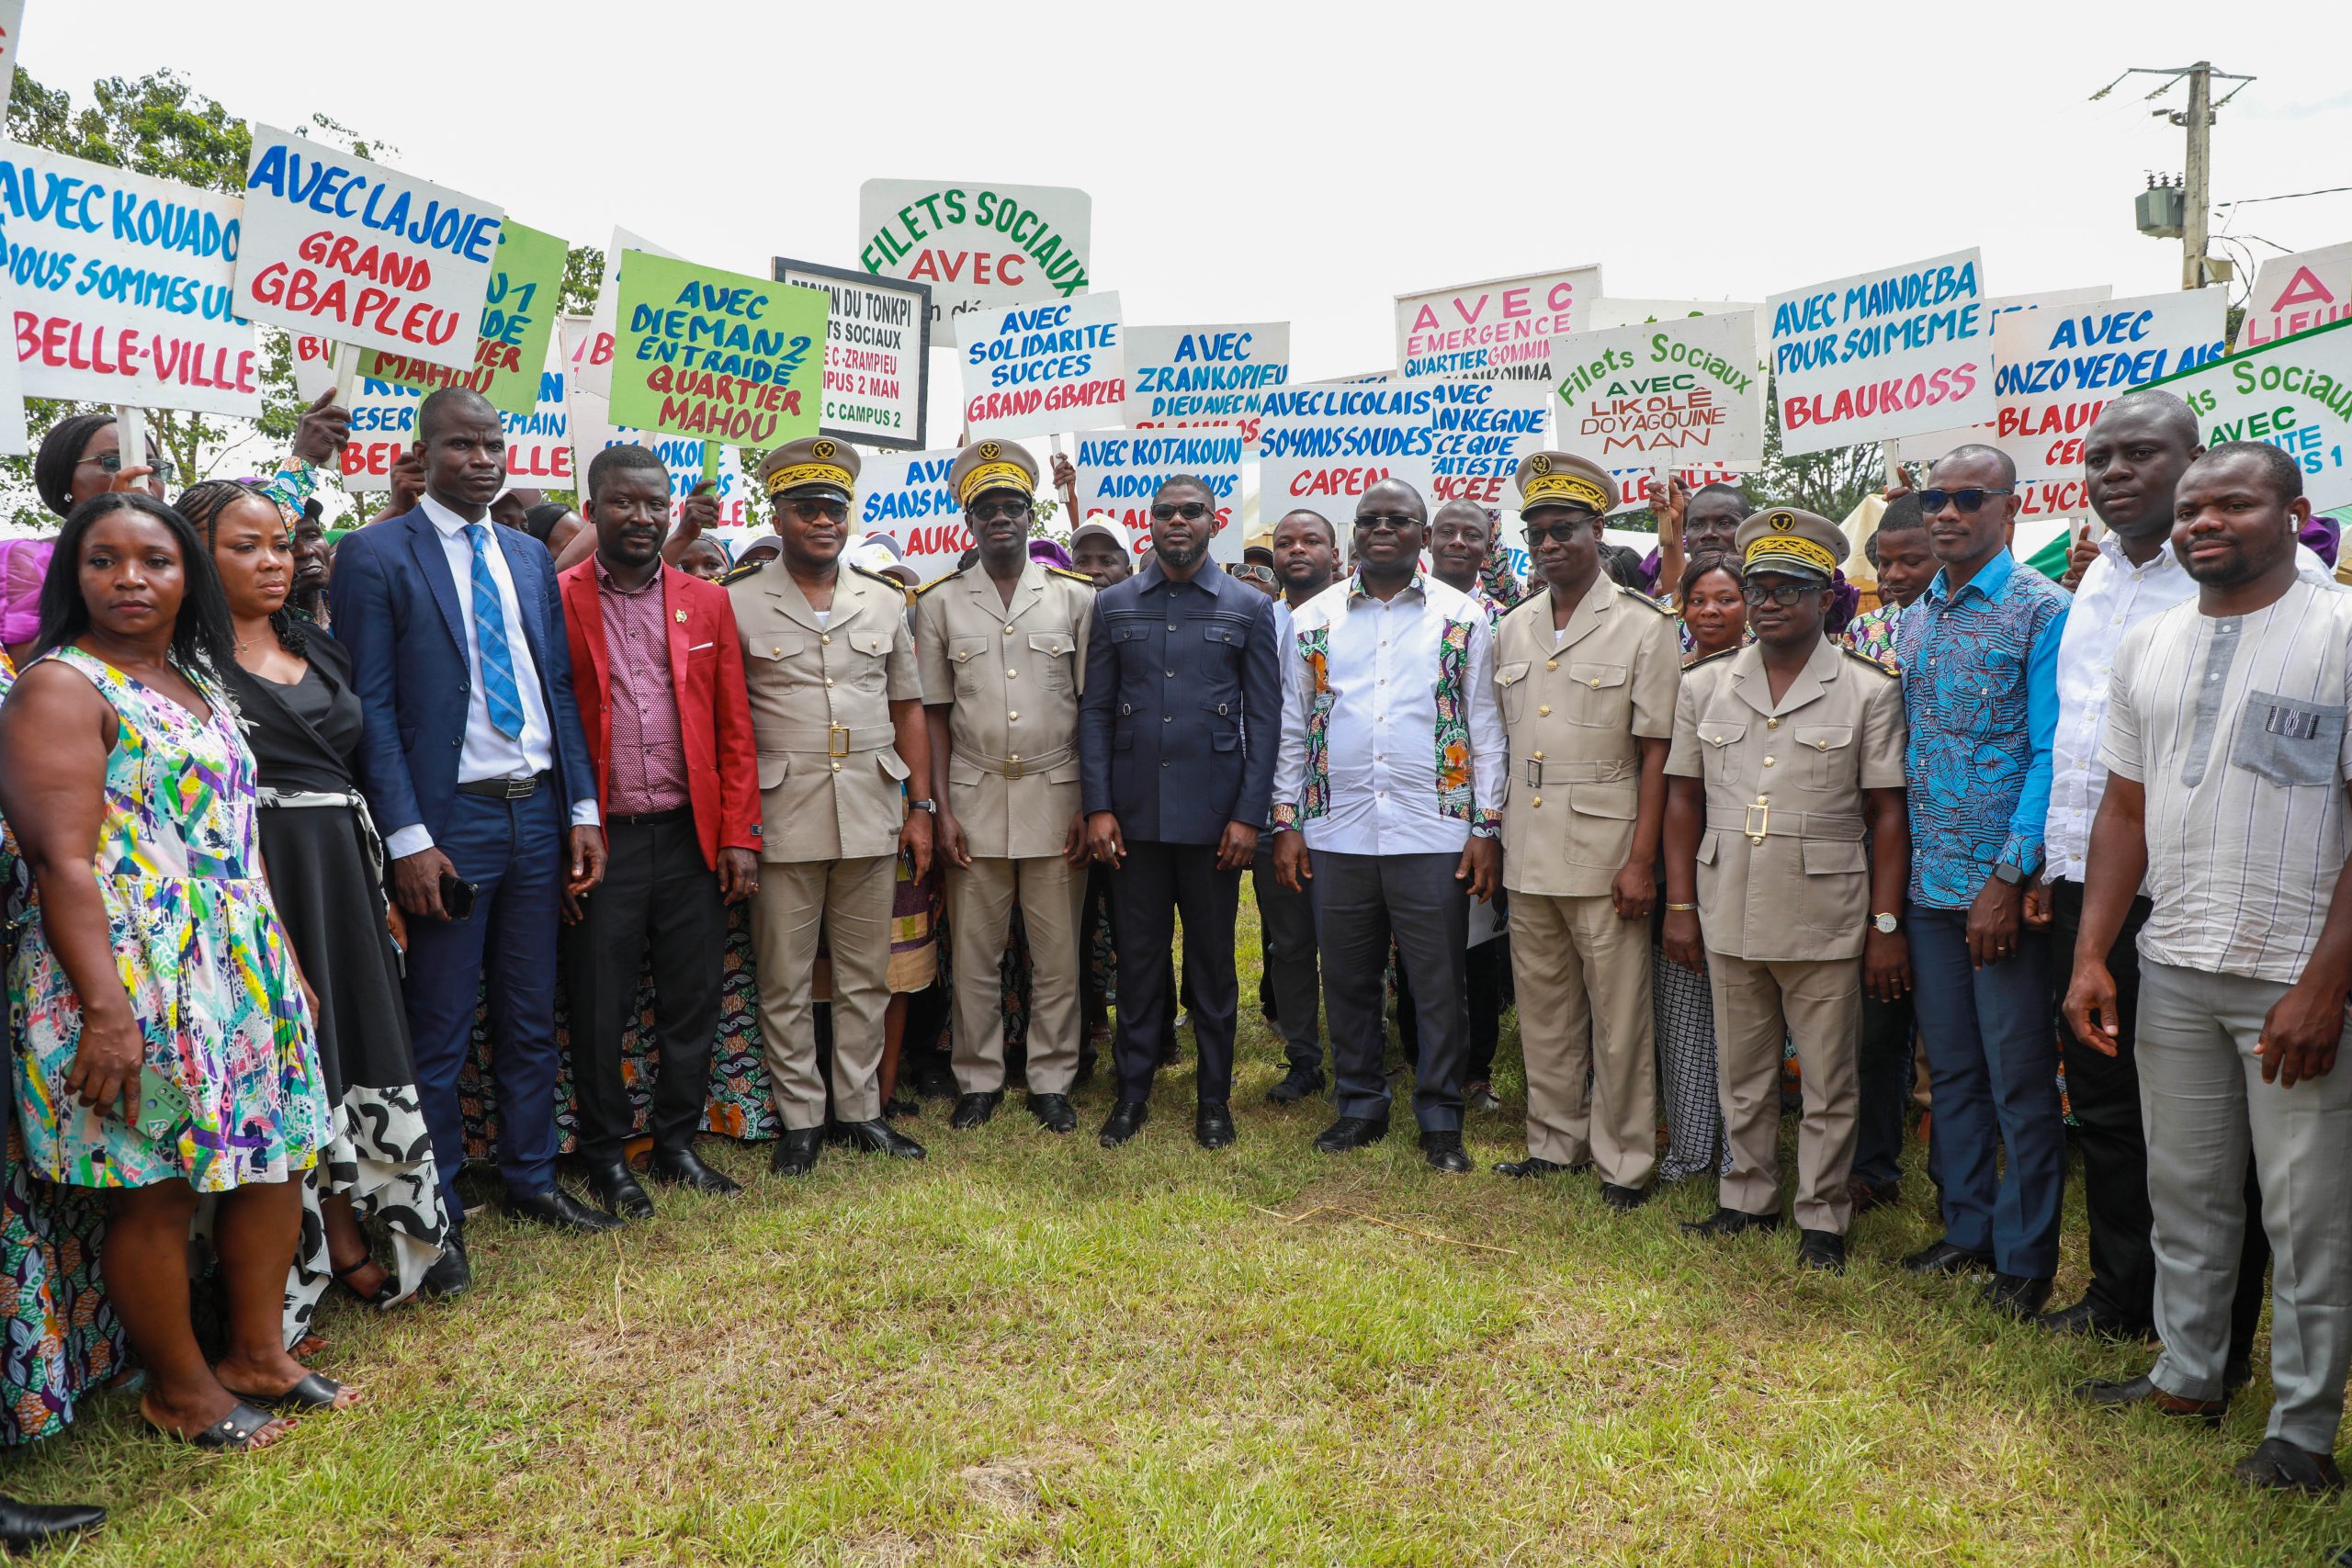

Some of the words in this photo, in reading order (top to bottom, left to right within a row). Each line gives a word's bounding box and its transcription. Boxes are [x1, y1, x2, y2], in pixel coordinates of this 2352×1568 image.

[0, 161, 105, 233] AVEC
[248, 145, 368, 219] AVEC
[362, 183, 411, 236] LA
[408, 200, 501, 264] JOIE
[299, 231, 432, 292] GRAND
[860, 188, 966, 275] FILETS
[975, 191, 1089, 299] SOCIAUX
[907, 249, 1026, 286] AVEC
[75, 259, 200, 315] SOMMES
[251, 262, 459, 345] GBAPLEU
[675, 280, 769, 320] AVEC
[1771, 292, 1837, 339] AVEC
[1843, 261, 1977, 323] MAINDEBA
[844, 288, 862, 319] DU
[865, 292, 911, 328] TONKPI
[1000, 305, 1071, 335] AVEC
[1411, 282, 1573, 333] AVEC
[845, 322, 901, 350] SOCIAUX
[968, 323, 1118, 365] SOLIDARITE
[1173, 332, 1253, 363] AVEC
[1407, 312, 1571, 356] EMERGENCE
[1778, 333, 1840, 376] POUR
[1839, 325, 1882, 364] SOI
[1883, 303, 1981, 355] MEME
[2048, 310, 2154, 351] AVEC
[14, 310, 256, 394] BELLE-VILLE
[636, 336, 801, 386] ENTRAIDE
[1404, 348, 1488, 378] QUARTIER
[1557, 346, 1634, 408] Filets
[1650, 333, 1754, 396] Sociaux
[647, 365, 801, 416] QUARTIER
[858, 375, 865, 395] 2
[869, 377, 899, 400] MAN
[991, 355, 1091, 388] SUCCES
[1135, 364, 1289, 393] ZRANKOPIEU
[1606, 374, 1696, 397] AVEC
[967, 388, 1043, 423] GRAND
[1151, 395, 1204, 417] DIEU
[1202, 394, 1244, 414] AVEC
[1261, 390, 1325, 417] AVEC
[1324, 390, 1432, 417] LICOLAIS
[1432, 384, 1493, 405] AVEC
[1784, 362, 1978, 430] BLAUKOSS
[659, 396, 778, 443] MAHOU
[839, 403, 890, 426] CAMPUS
[894, 412, 901, 429] 2
[1580, 407, 1727, 435] DOYAGOUINE
[2208, 405, 2297, 449] AVEC
[1077, 439, 1129, 467] AVEC
[1132, 437, 1241, 467] KOTAKOUN
[1260, 427, 1342, 458] SOYONS
[1342, 426, 1433, 457] SOUDES
[1466, 434, 1521, 457] QUE
[1602, 428, 1712, 455] MAN
[862, 489, 932, 523] SANS
[1431, 476, 1507, 502] YCEE
